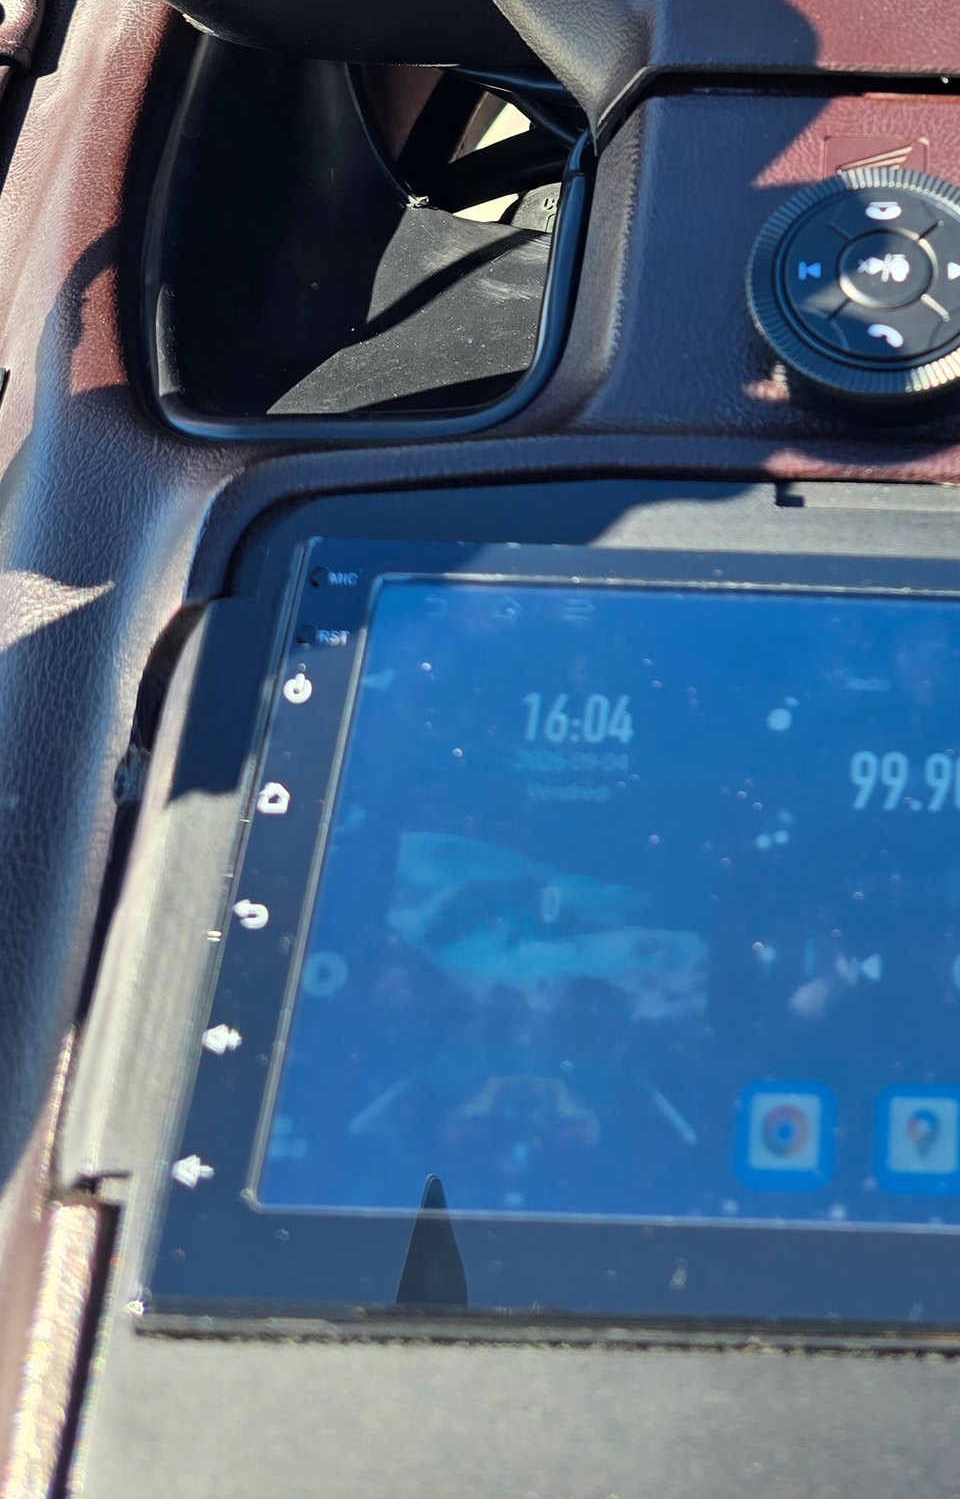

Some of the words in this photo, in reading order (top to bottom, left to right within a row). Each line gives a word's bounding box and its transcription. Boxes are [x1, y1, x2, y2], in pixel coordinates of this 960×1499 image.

[329, 571, 359, 587] MIC
[316, 629, 351, 646] RST
[522, 693, 634, 744] 16:04
